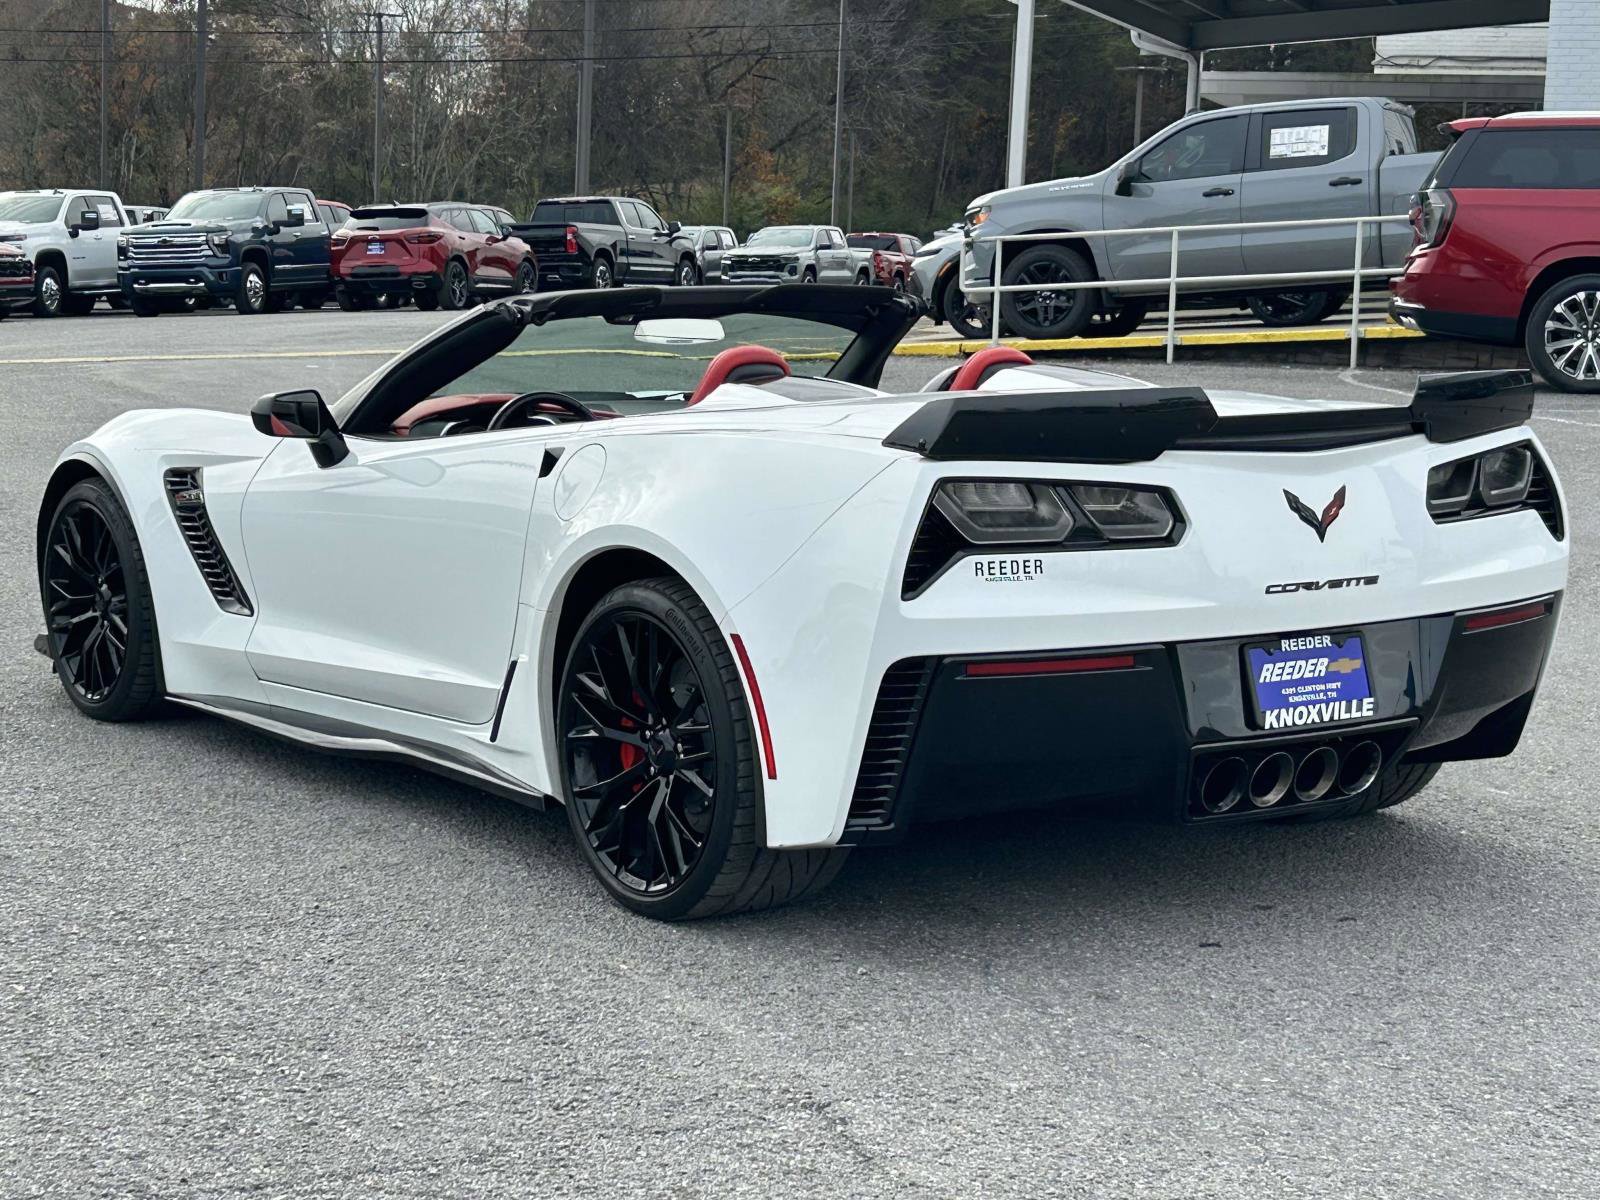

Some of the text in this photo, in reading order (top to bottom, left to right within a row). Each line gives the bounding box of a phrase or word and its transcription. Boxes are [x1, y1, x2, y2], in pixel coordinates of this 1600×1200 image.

[974, 559, 1043, 577] REEDER
[1265, 575, 1380, 594] CORVETTE
[664, 608, 704, 657] Continental
[1280, 635, 1332, 652] REEDER
[1259, 657, 1329, 683] REEDER
[1296, 684, 1326, 693] CLINTON
[1264, 697, 1375, 730] KNOXVILLE
